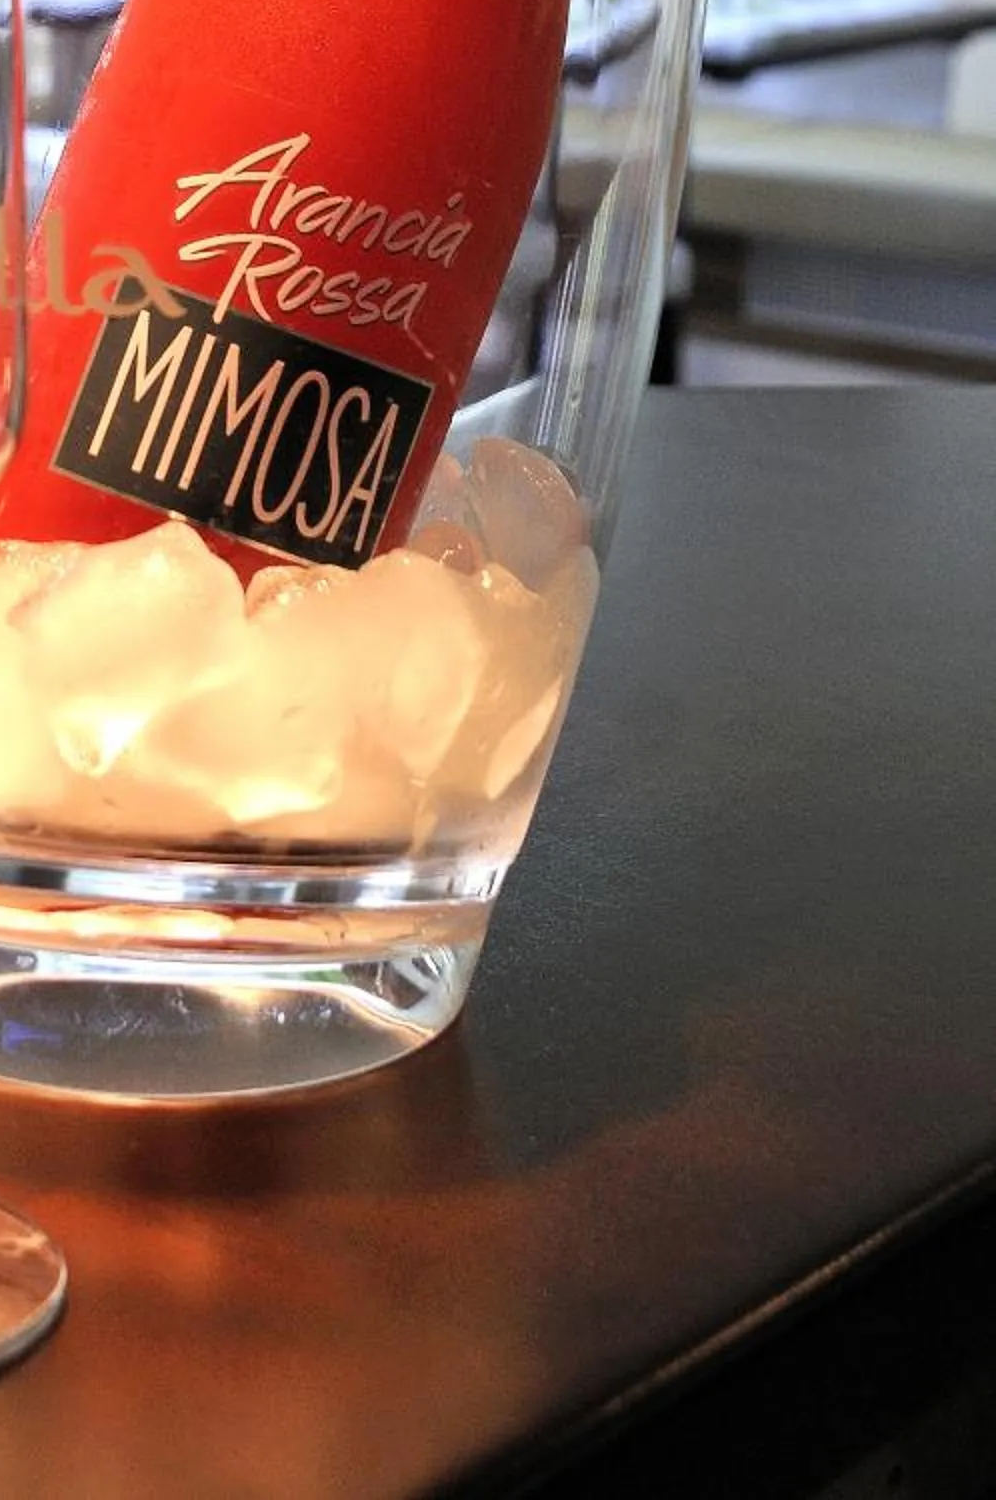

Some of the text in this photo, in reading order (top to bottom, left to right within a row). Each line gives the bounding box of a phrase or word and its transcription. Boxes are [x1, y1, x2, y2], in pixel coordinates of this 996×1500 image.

[175, 132, 473, 268] Arancia
[179, 233, 434, 360] Rossa
[87, 310, 400, 553] MIMOSA
